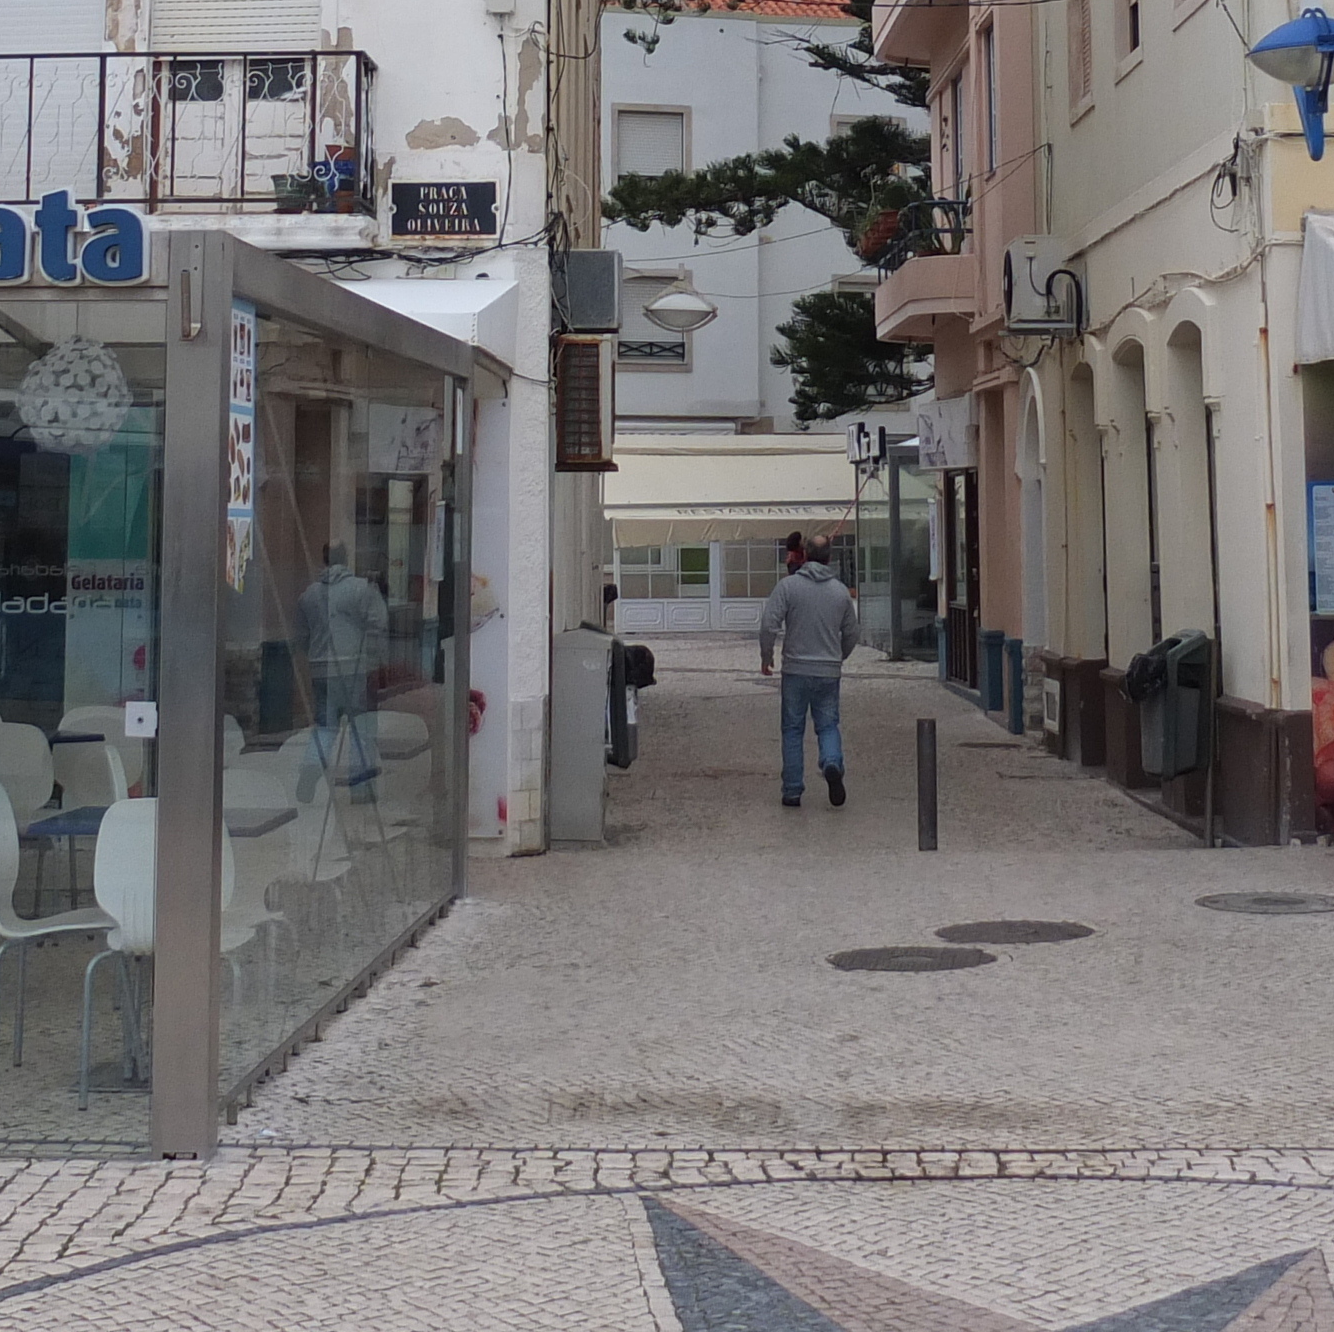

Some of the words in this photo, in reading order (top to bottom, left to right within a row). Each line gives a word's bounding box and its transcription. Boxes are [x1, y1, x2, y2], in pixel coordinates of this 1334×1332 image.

[419, 186, 468, 202] PRAÇA
[418, 201, 469, 216] SOUZA
[406, 217, 481, 232] OLIVEIRA
[675, 505, 816, 517] RESTAURANTE
[70, 572, 145, 591] Gelataria
